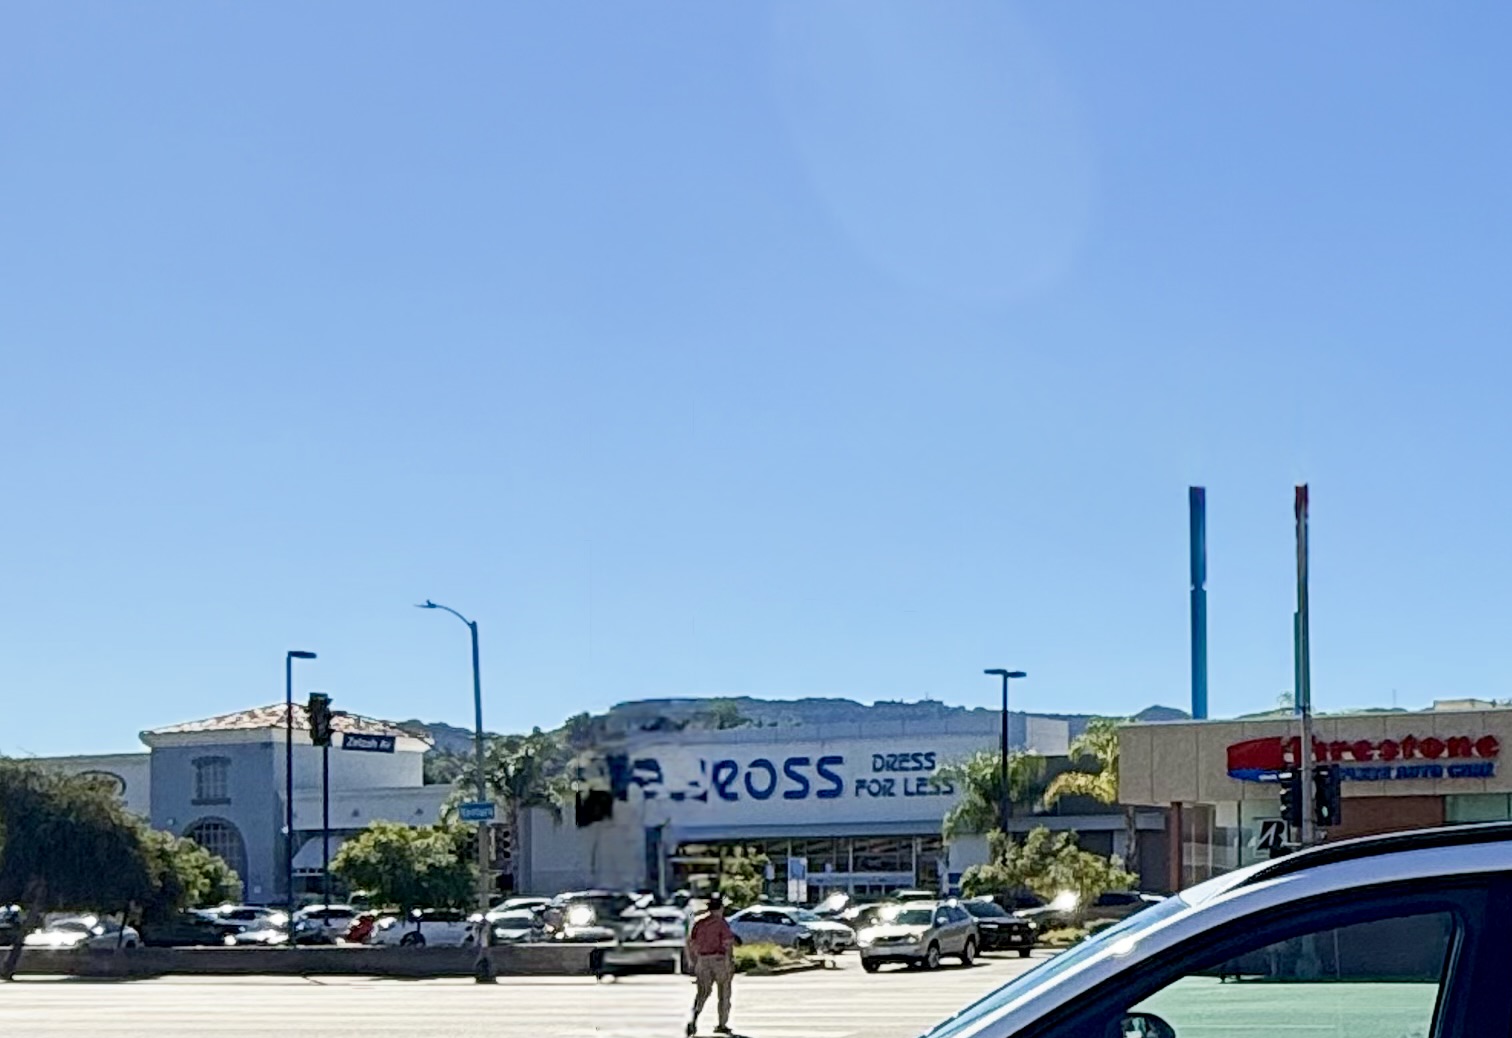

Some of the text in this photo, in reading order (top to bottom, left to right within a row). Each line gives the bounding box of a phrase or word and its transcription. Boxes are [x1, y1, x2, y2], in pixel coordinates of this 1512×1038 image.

[872, 751, 936, 772] DRESS
[854, 775, 955, 798] FOR LESS
